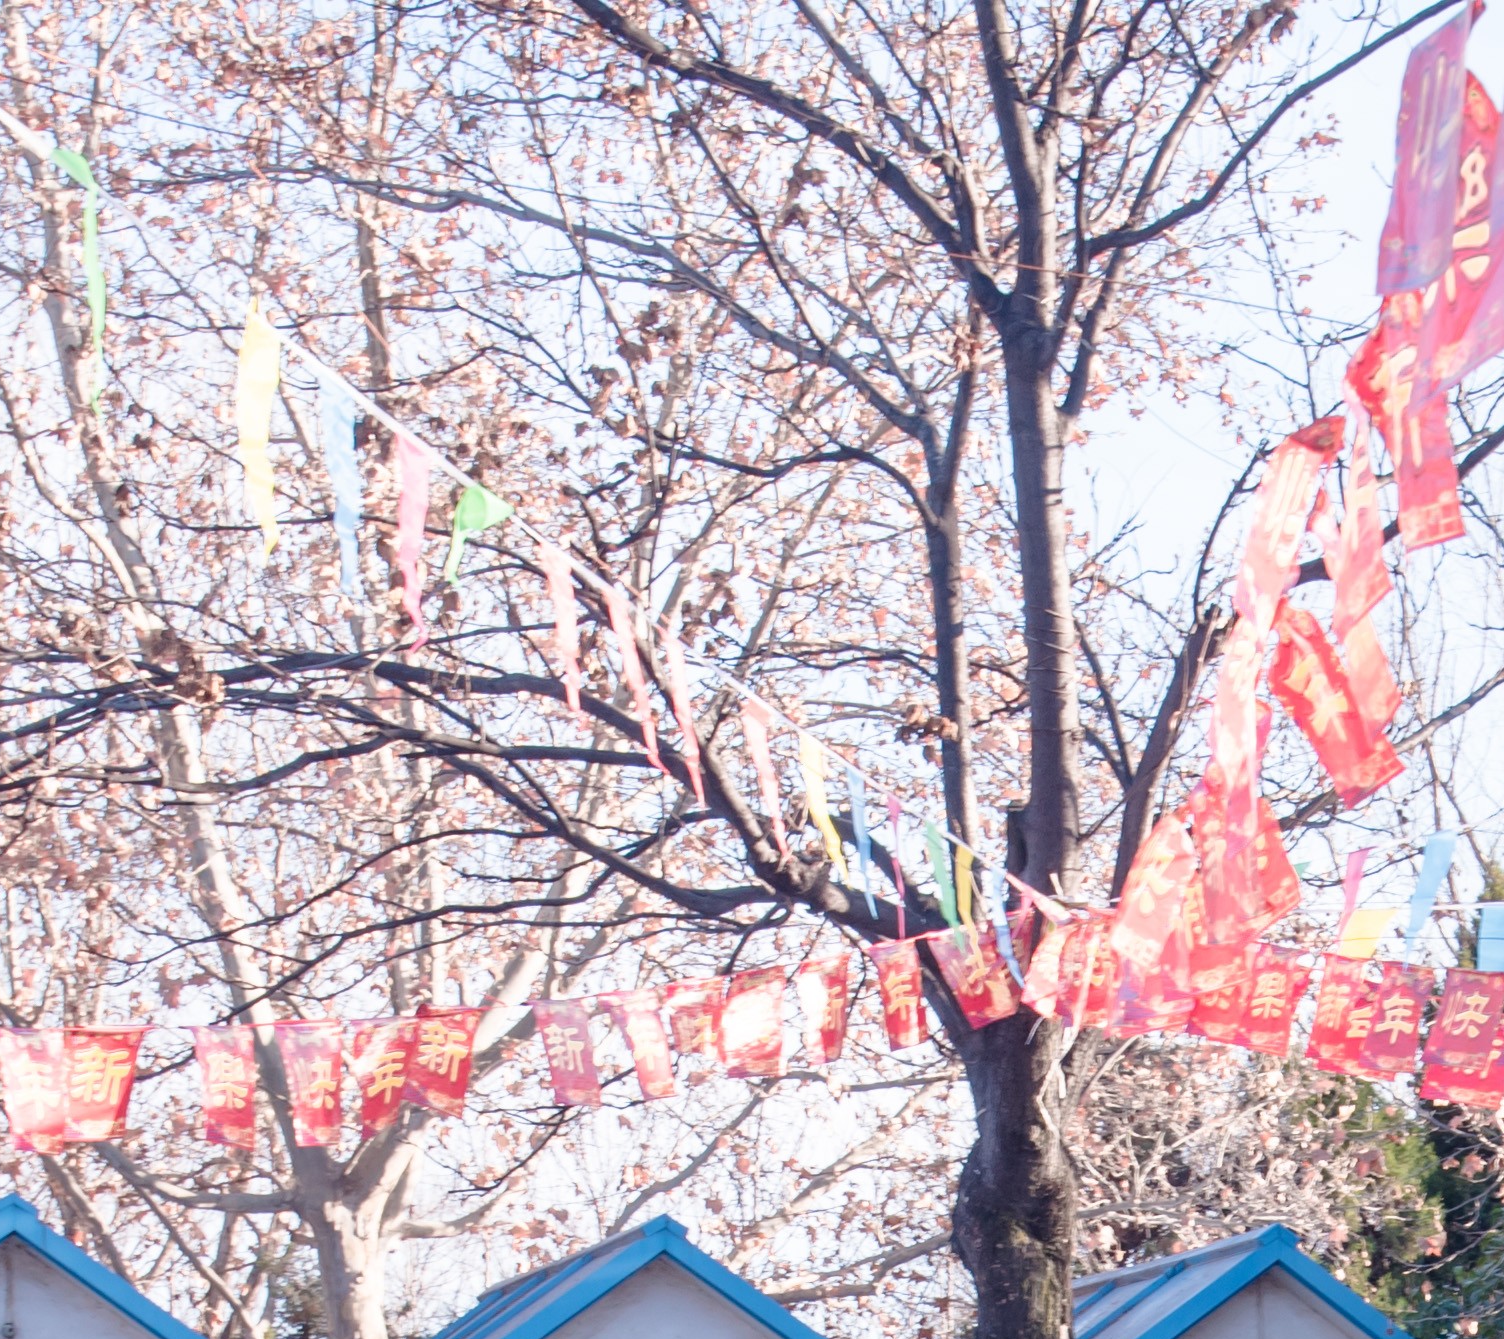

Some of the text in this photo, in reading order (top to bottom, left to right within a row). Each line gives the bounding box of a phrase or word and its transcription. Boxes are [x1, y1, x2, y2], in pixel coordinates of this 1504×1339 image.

[1251, 971, 1286, 1020] 樂
[1374, 992, 1415, 1045] 年
[1442, 987, 1492, 1039] 快
[419, 1021, 470, 1082] 新
[542, 1021, 586, 1075] 新
[71, 1046, 133, 1107] 新
[207, 1051, 249, 1110] 樂
[366, 1050, 406, 1104] 年
